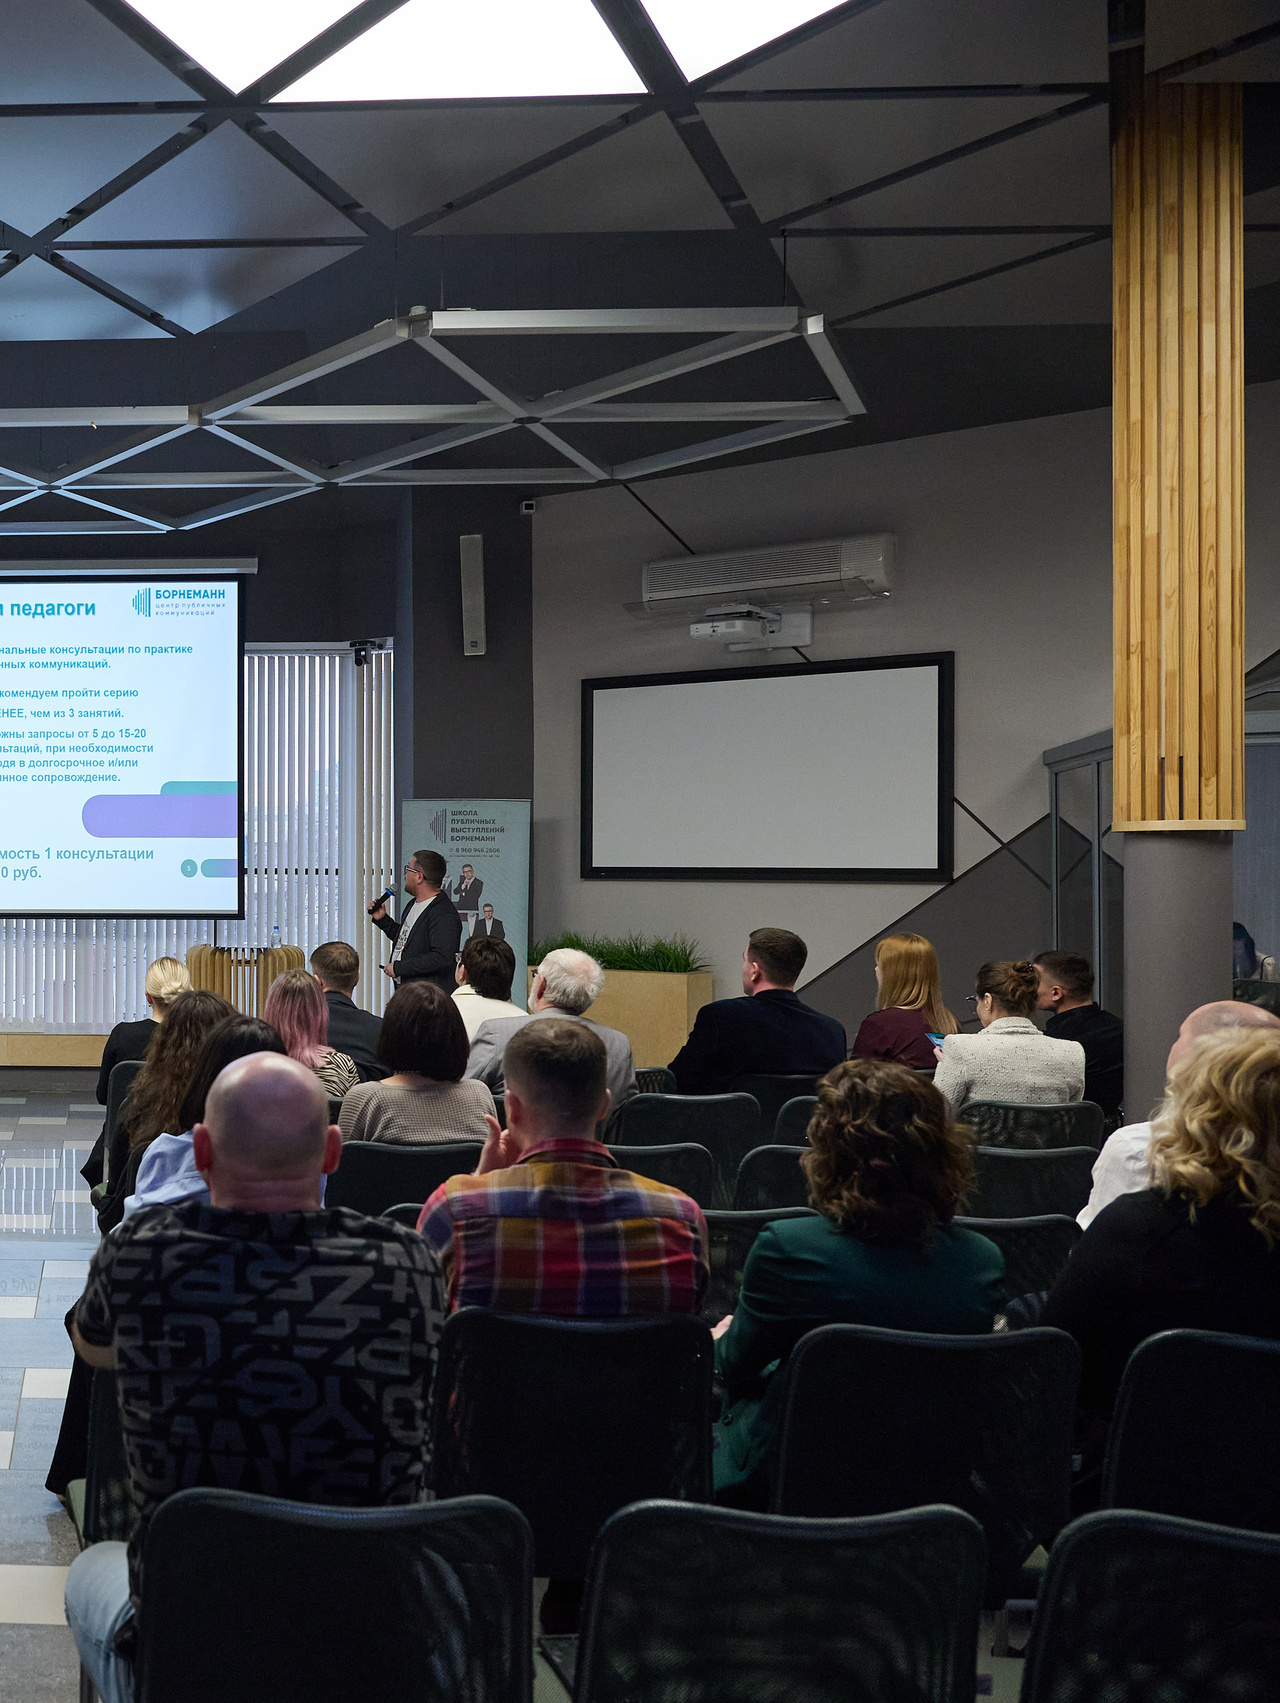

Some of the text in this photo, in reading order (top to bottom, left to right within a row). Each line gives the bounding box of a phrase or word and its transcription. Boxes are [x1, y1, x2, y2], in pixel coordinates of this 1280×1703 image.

[155, 589, 225, 599] БОРНЕМАНН
[10, 602, 96, 619] педагоги
[49, 645, 125, 657] консультации
[127, 646, 141, 655] по
[144, 645, 193, 656] практике
[29, 659, 112, 671] коммуникаций.
[61, 687, 101, 699] пройти
[103, 689, 139, 699] серию
[30, 710, 51, 718] чем
[53, 710, 66, 718] из
[68, 708, 75, 718] 3
[77, 708, 124, 718] занятий.
[27, 730, 75, 741] запросы
[77, 730, 90, 739] от
[92, 729, 99, 738] 5
[101, 729, 115, 740] до
[118, 728, 147, 738] 15-20
[45, 744, 66, 755] при
[68, 743, 154, 755] необходимости
[19, 760, 26, 768] в
[28, 758, 105, 770] долгосрочное
[108, 758, 139, 768] и/или
[31, 773, 121, 784] сопровождение.
[44, 847, 51, 859] 1
[56, 848, 154, 862] консультации
[13, 866, 42, 881] руб.
